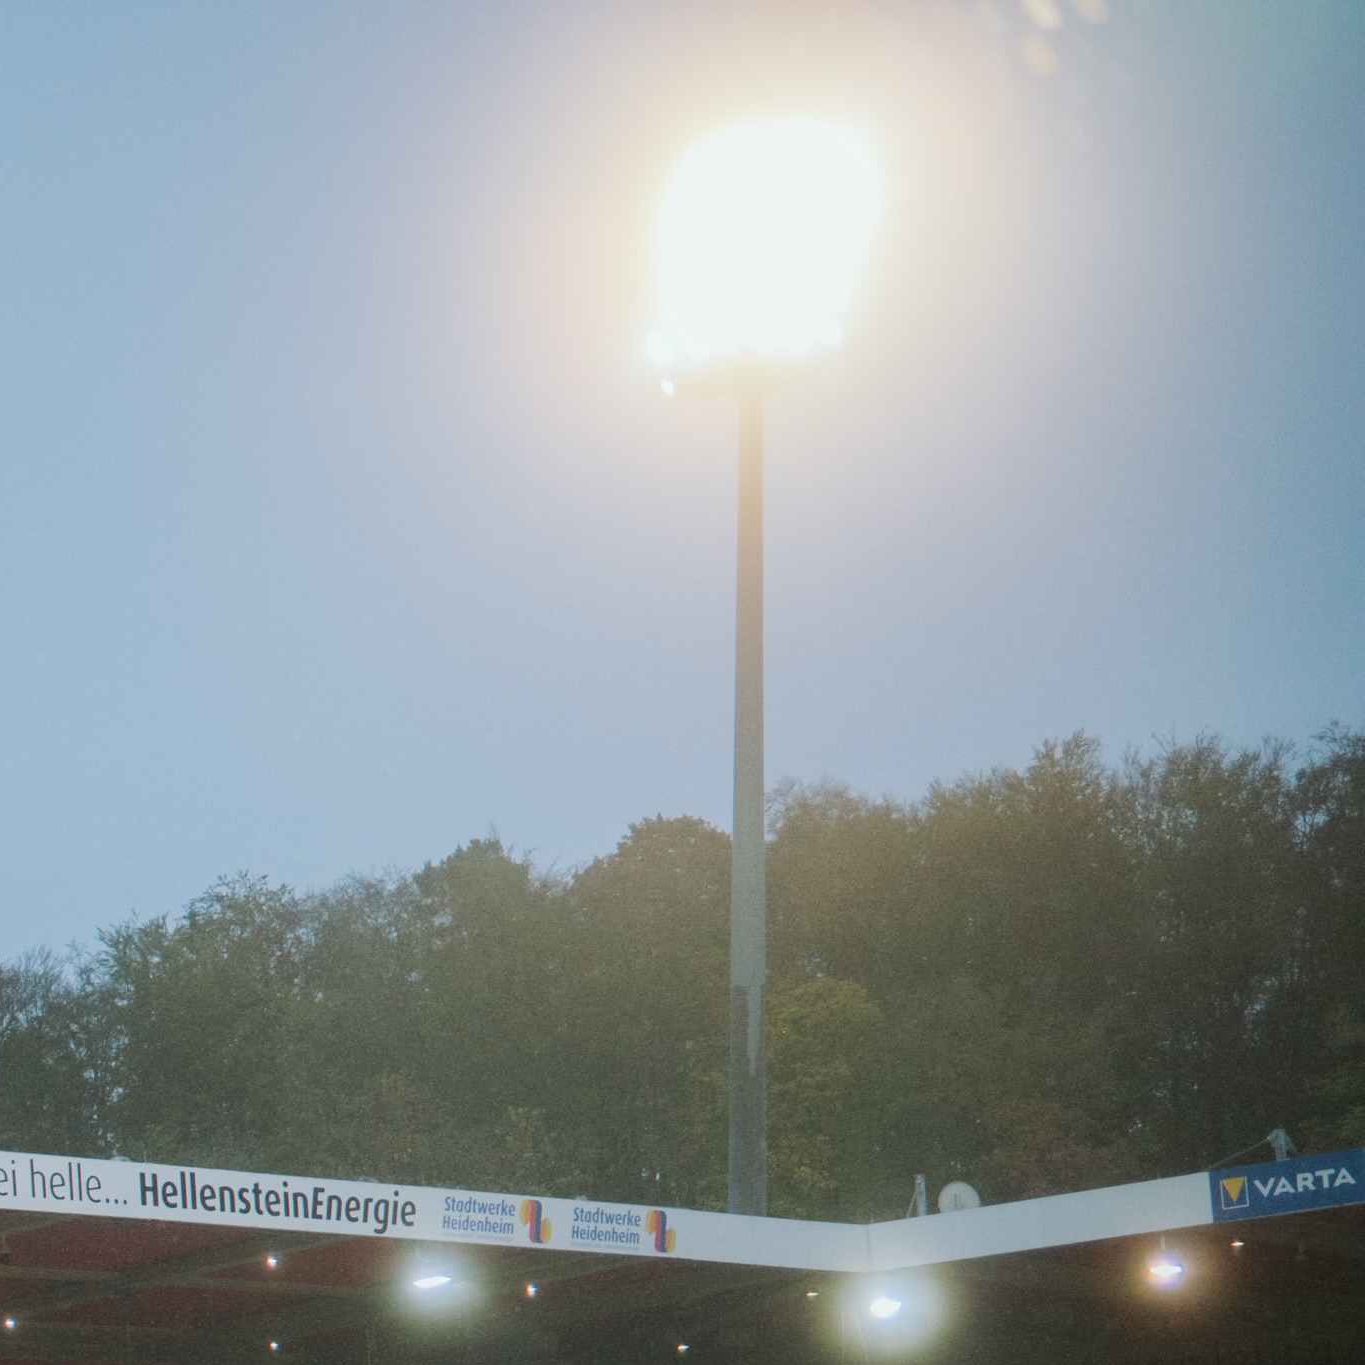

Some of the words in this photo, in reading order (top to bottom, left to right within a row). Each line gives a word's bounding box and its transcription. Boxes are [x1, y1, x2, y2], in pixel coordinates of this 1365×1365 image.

[31, 1159, 128, 1206] helle...
[1253, 1166, 1356, 1199] VARTA
[139, 1171, 416, 1234] HellensteinEnergie
[444, 1196, 516, 1217] Stadtwerke
[442, 1215, 514, 1235] Heidenheim
[573, 1207, 642, 1227] Stadtwerke
[571, 1225, 640, 1244] Heidenheim
